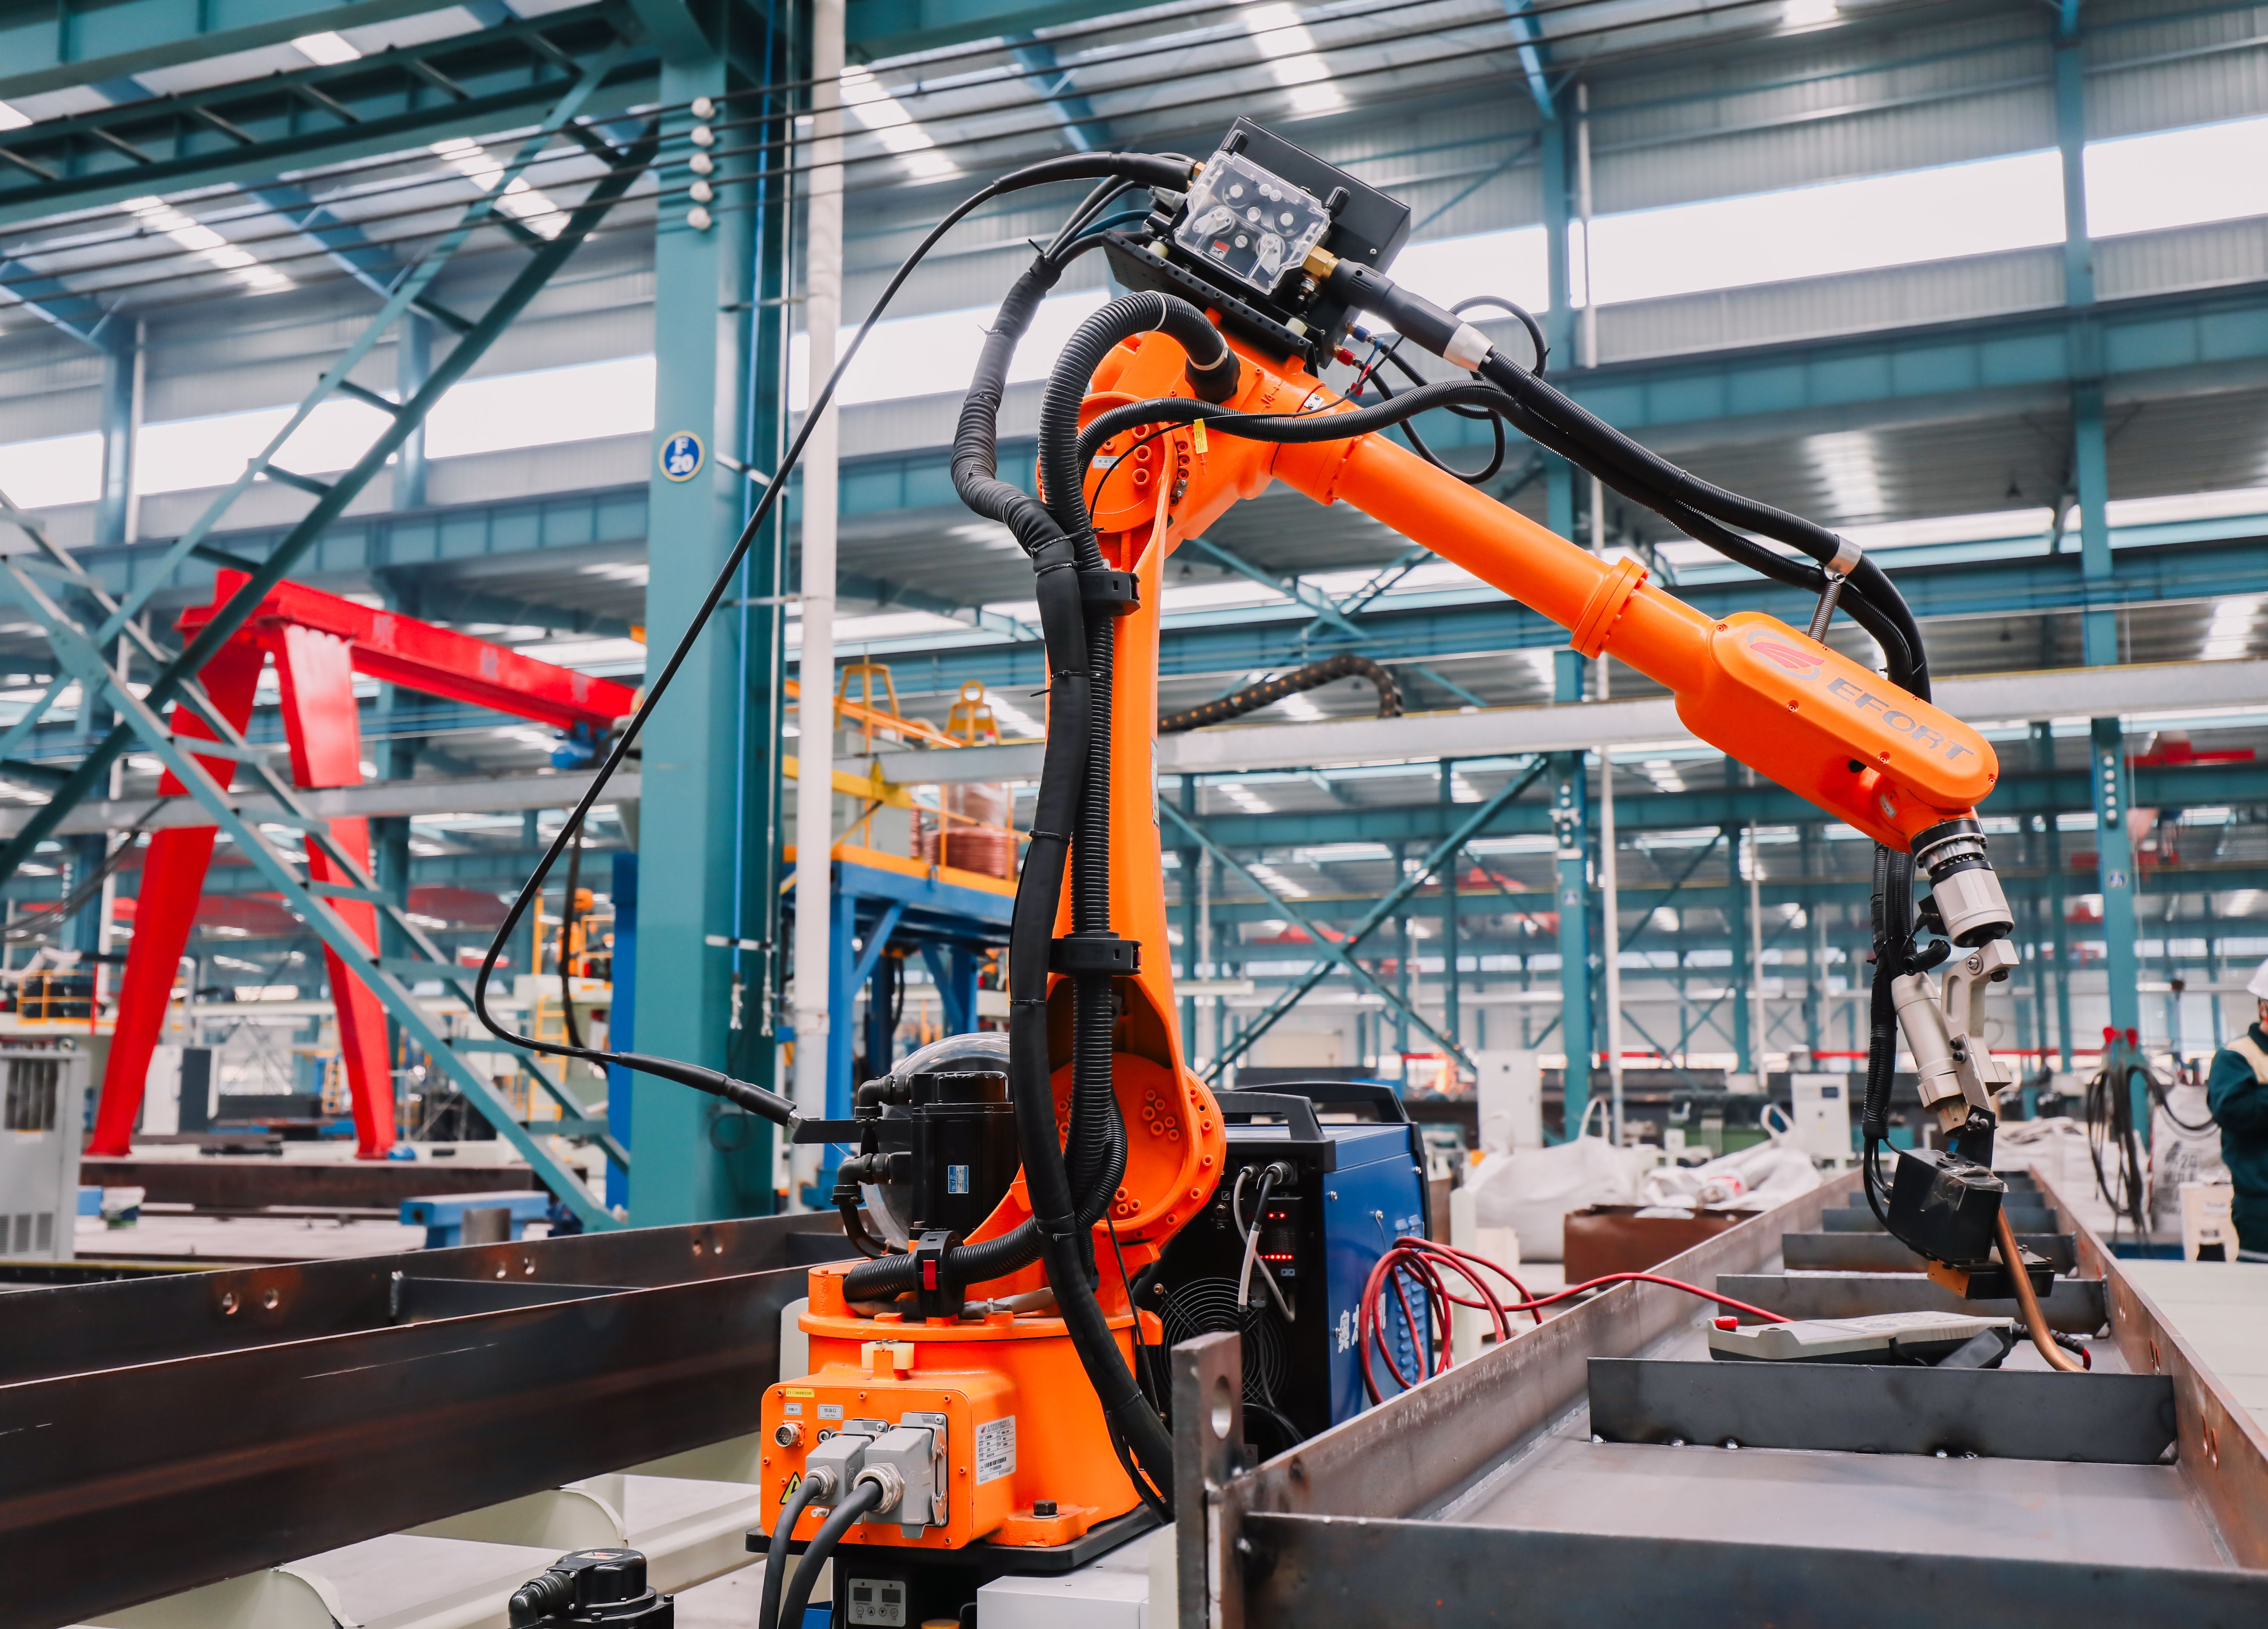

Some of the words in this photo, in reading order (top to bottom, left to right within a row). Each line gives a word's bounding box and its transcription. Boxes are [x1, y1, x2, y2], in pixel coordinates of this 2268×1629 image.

[674, 437, 689, 455] F
[669, 454, 694, 473] 20
[1827, 677, 1974, 760] EFORT
